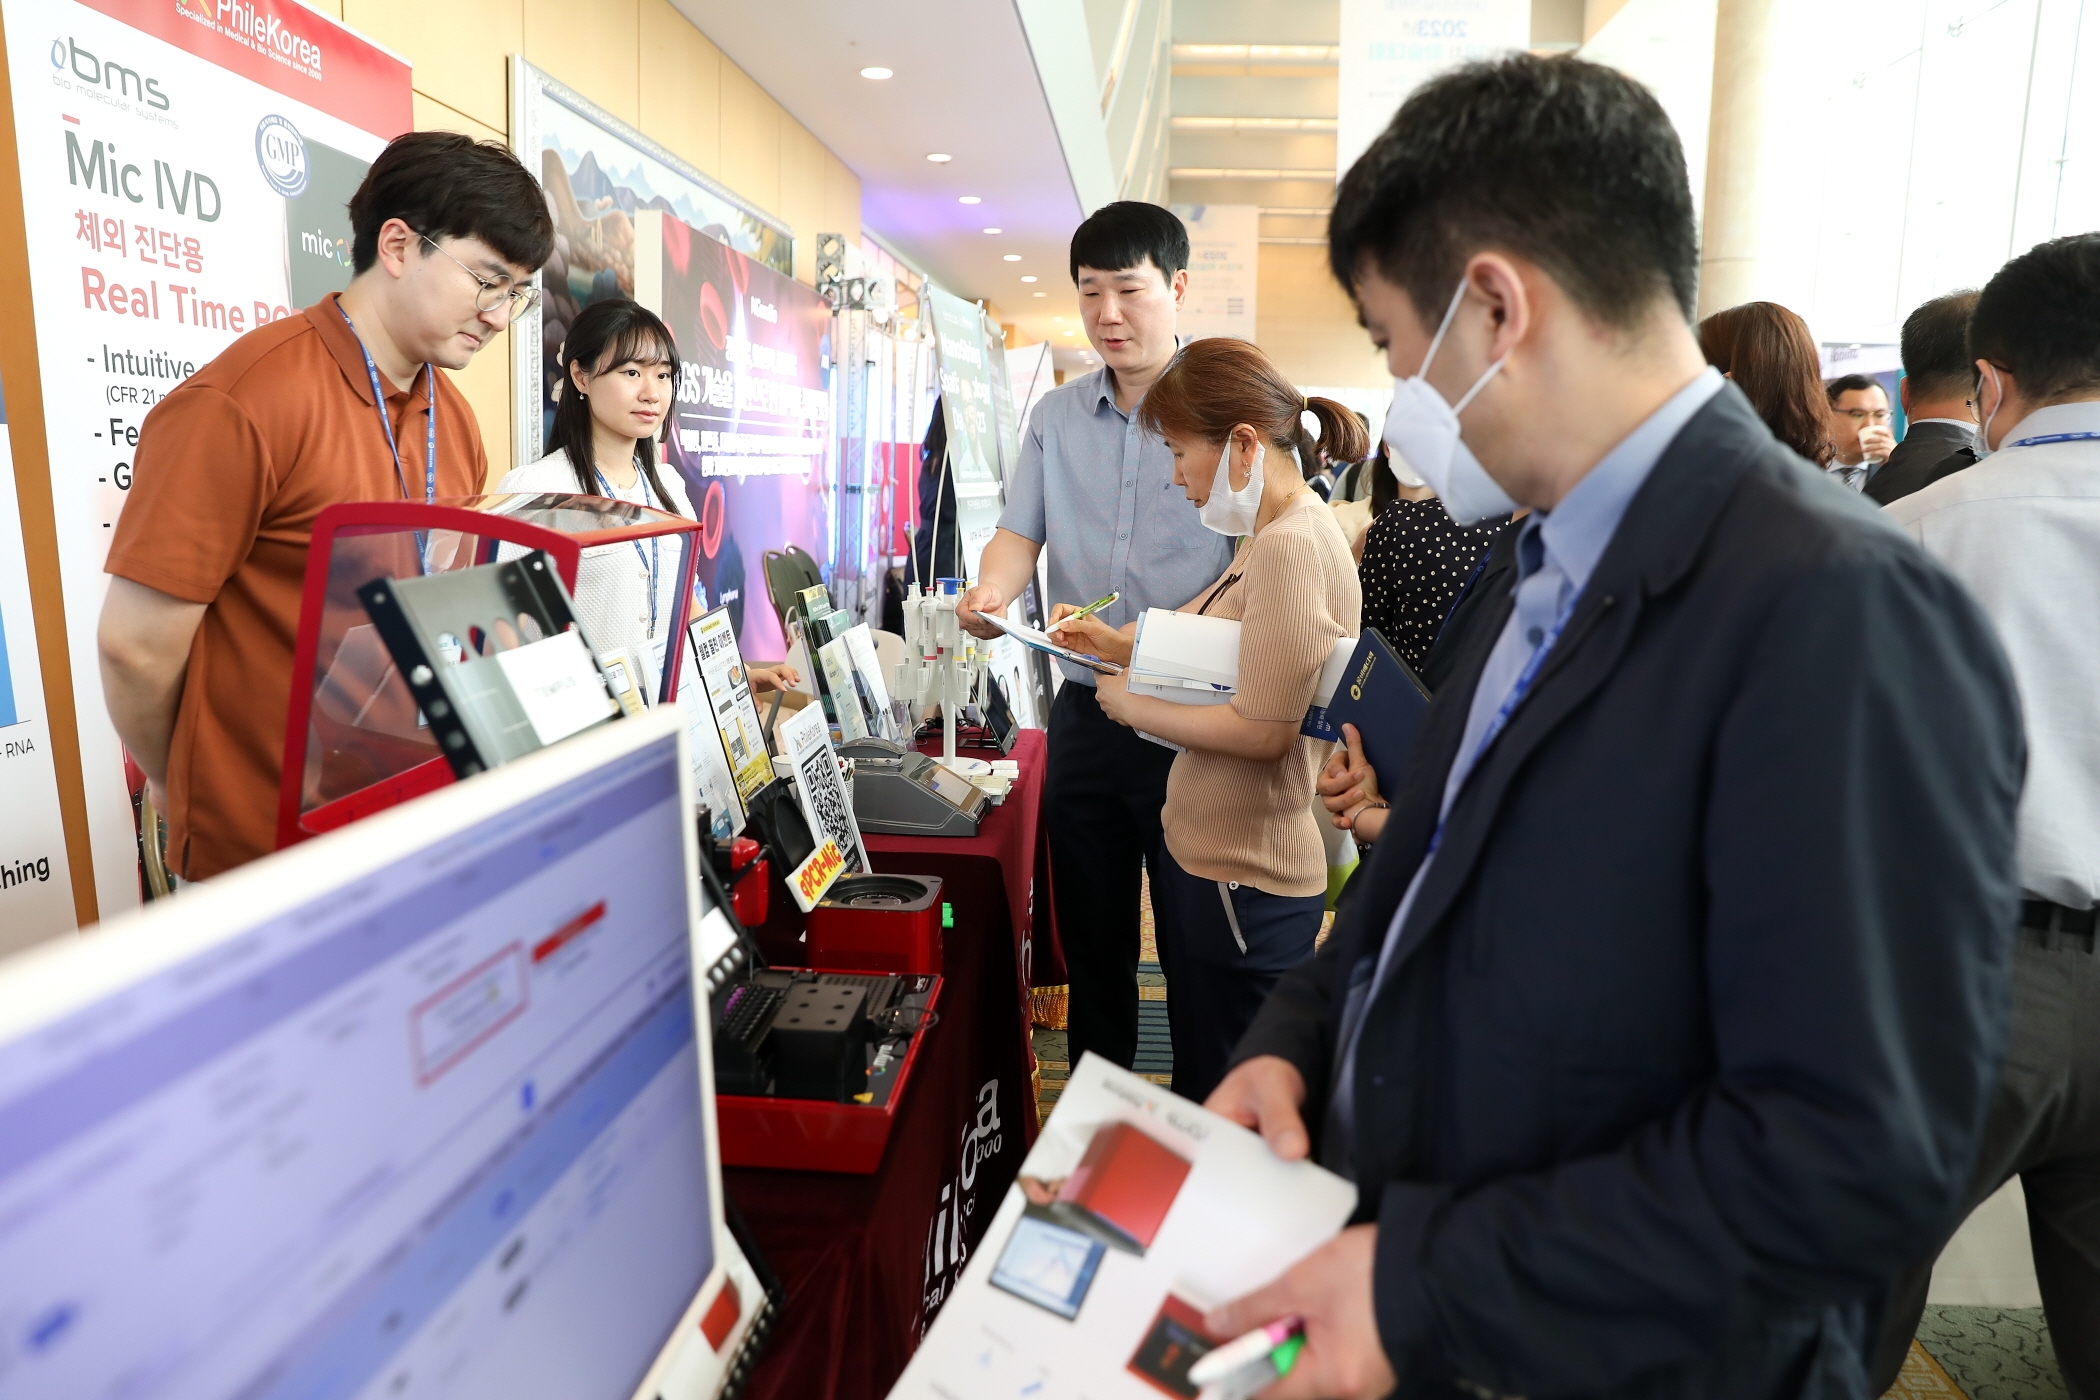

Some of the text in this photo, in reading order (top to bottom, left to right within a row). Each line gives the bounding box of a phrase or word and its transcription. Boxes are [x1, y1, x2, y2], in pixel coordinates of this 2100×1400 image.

[176, 3, 322, 81] Specialized in Medical & Bio Science since 2000
[217, 0, 321, 71] PhileKorea
[69, 36, 170, 111] bms
[53, 74, 179, 130] bio molecular systems
[265, 134, 299, 166] GMP
[65, 130, 144, 204] Mic
[154, 159, 221, 223] IVD
[75, 208, 204, 274] 체외 진단용
[302, 229, 333, 259] mic
[81, 266, 159, 320] Real
[168, 284, 245, 333] Time
[103, 344, 195, 379] Intuitive
[677, 360, 701, 405] GS
[106, 384, 138, 406] (CFR
[141, 388, 156, 405] 21
[109, 418, 139, 447] Fe
[5, 738, 36, 759] RNA
[0, 856, 51, 890] hing
[799, 842, 843, 901] qPCR-Mic
